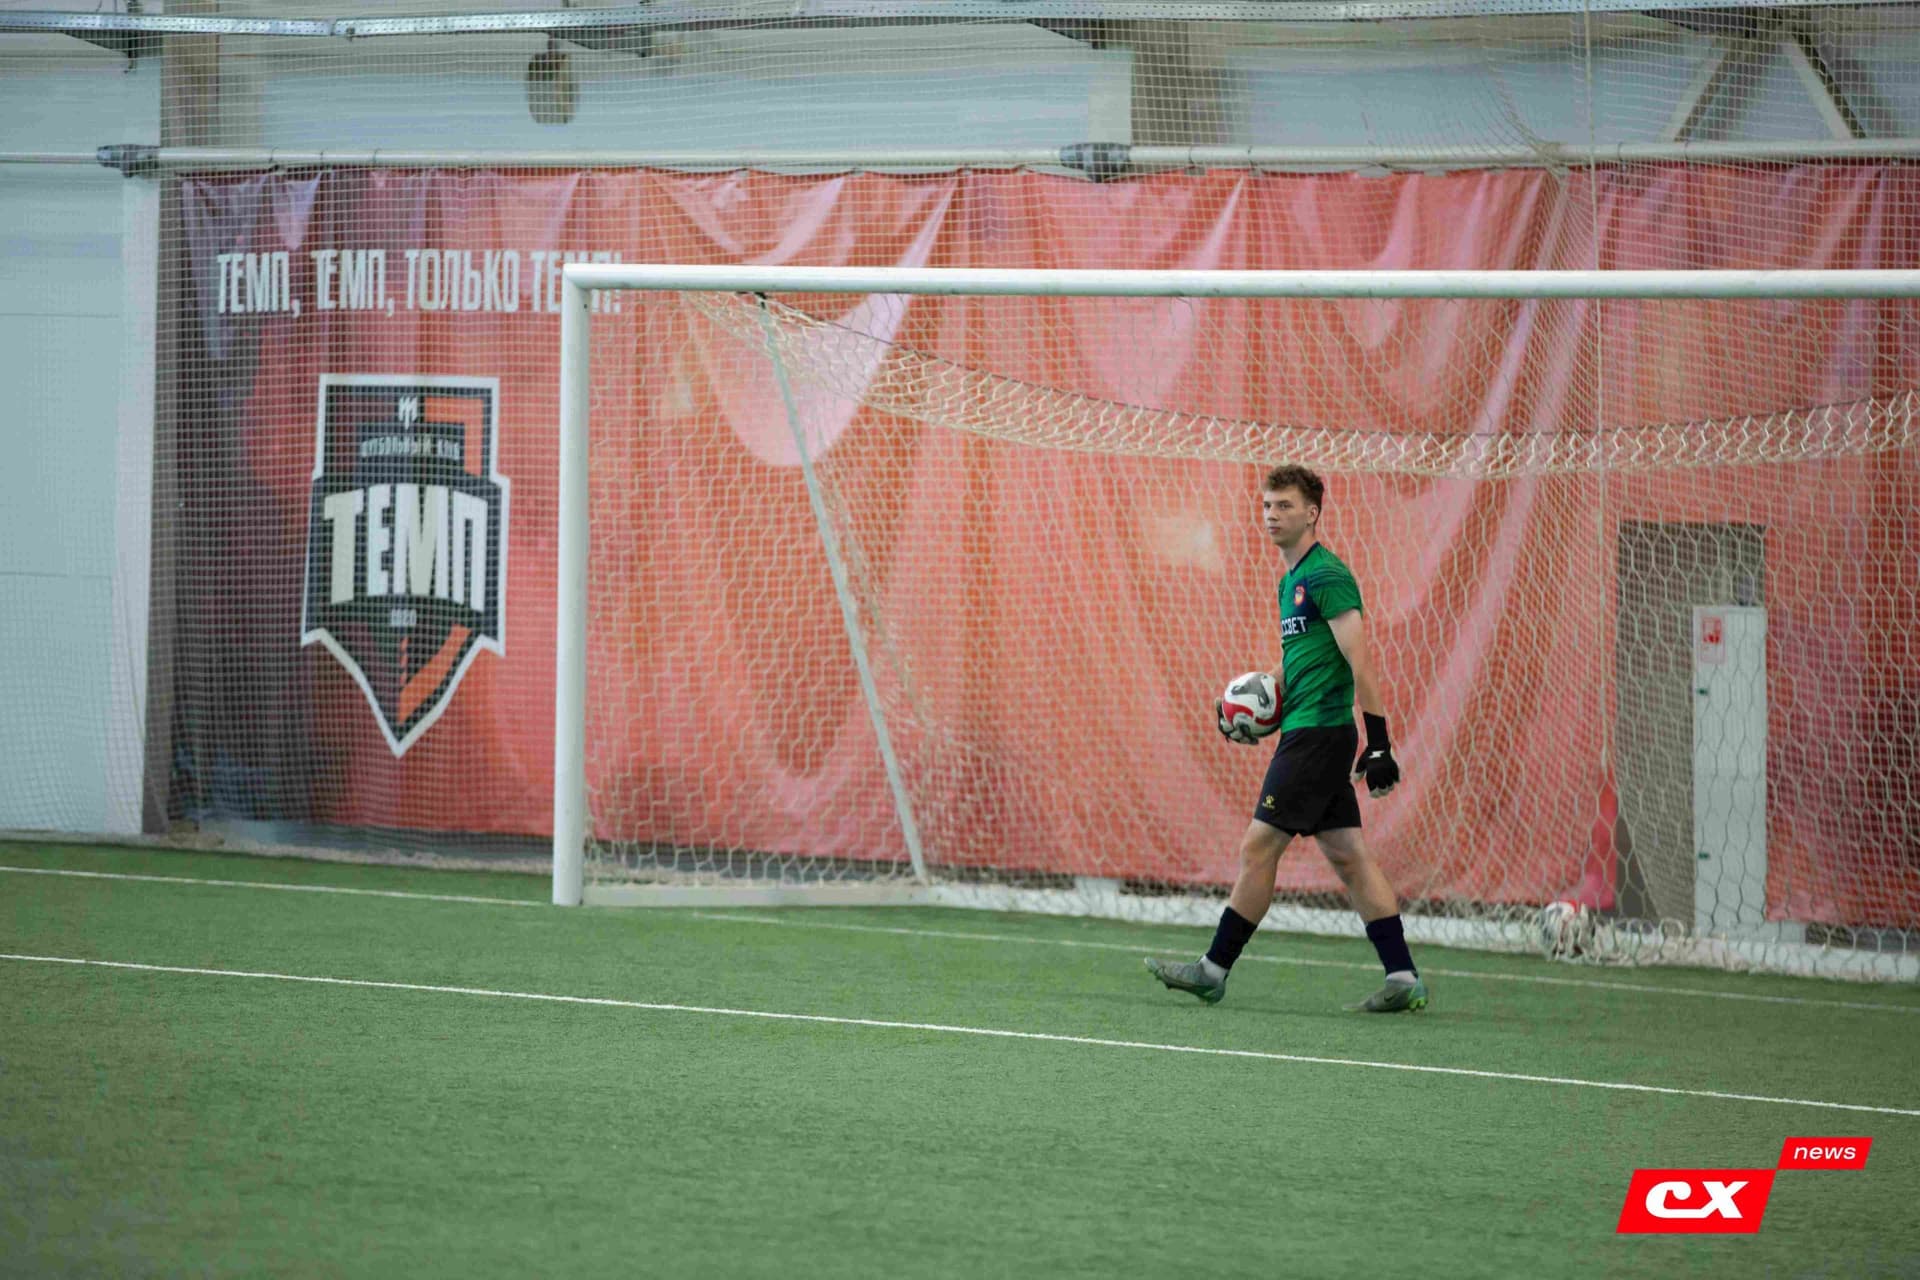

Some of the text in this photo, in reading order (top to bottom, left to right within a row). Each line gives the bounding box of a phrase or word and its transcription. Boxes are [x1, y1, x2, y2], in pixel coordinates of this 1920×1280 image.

[217, 249, 621, 318] ТЕМП, ТЕМП, ТОЛЬКО ТЕП!
[324, 483, 488, 613] ТЕМП
